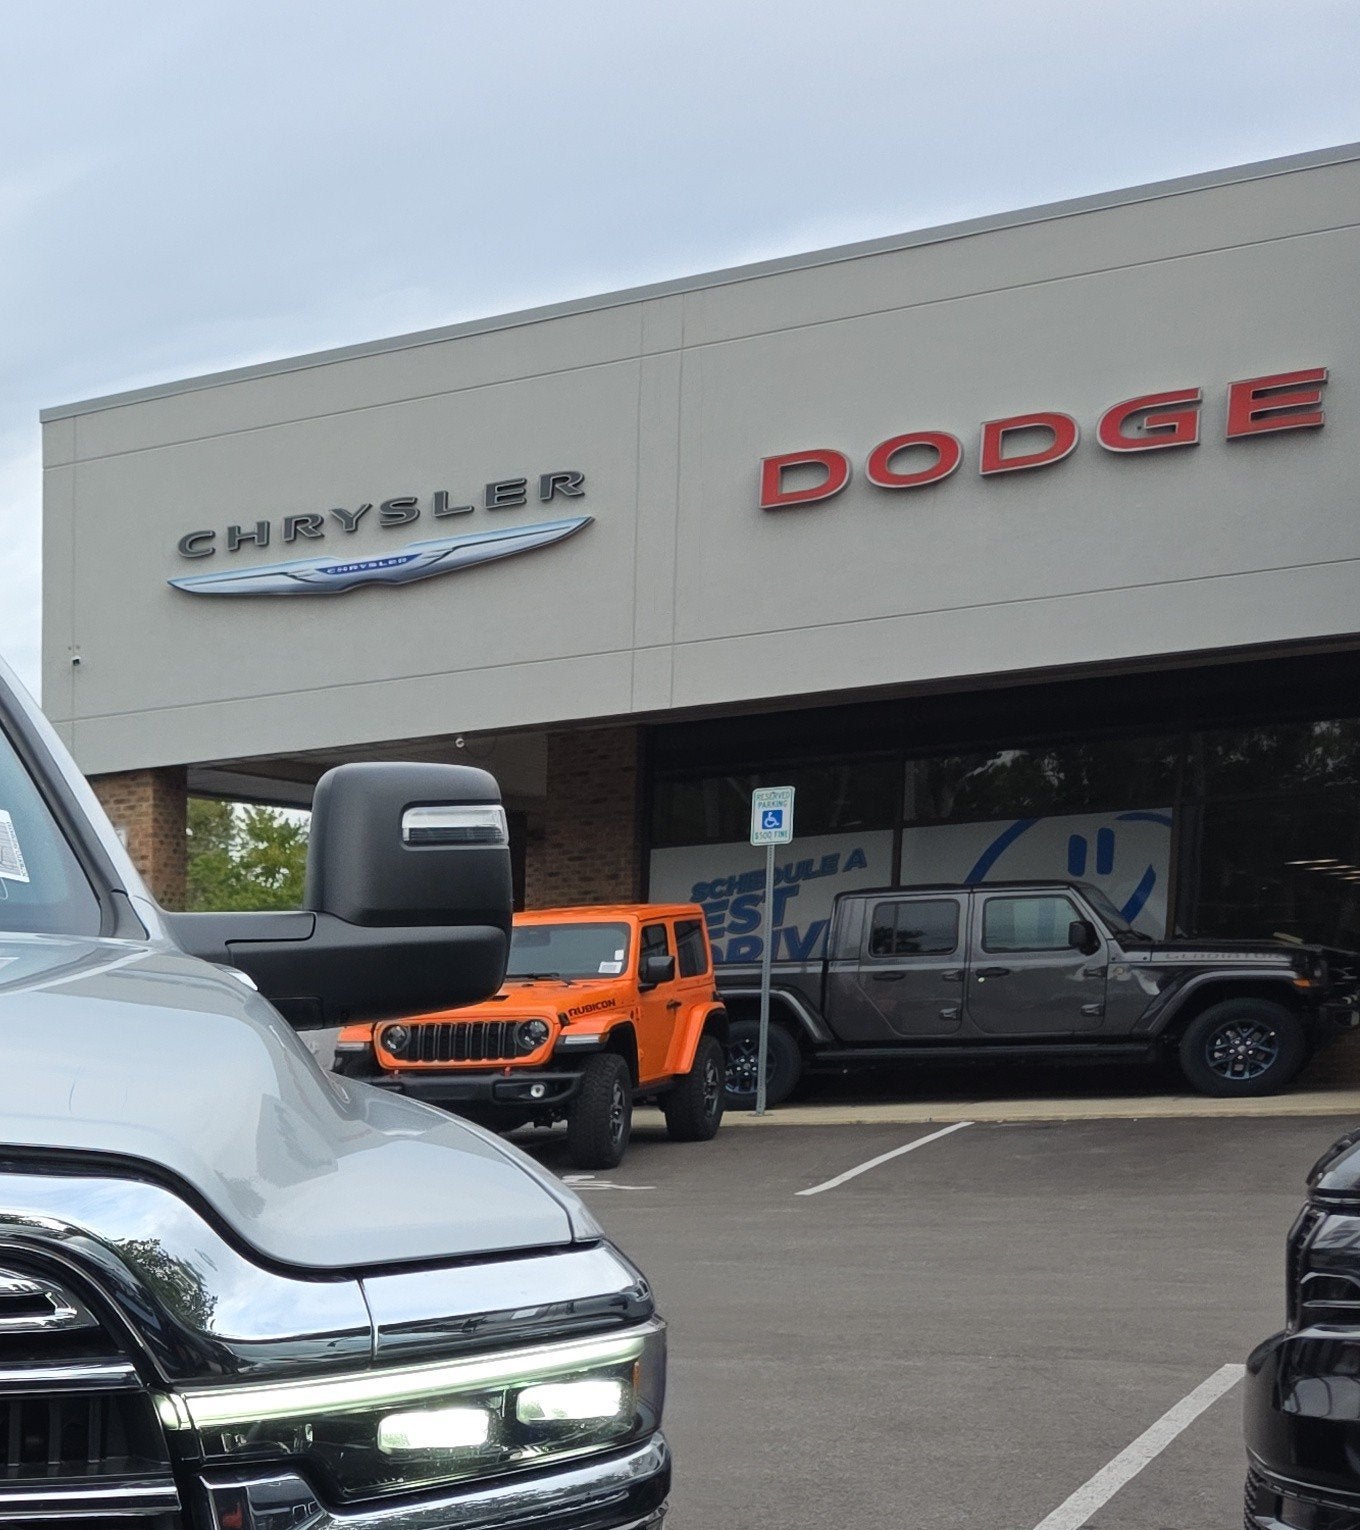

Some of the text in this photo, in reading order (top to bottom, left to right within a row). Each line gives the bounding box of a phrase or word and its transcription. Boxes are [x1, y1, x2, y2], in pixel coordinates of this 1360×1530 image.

[758, 366, 1329, 510] DODGE
[177, 469, 585, 558] CHRYSLER
[326, 557, 407, 574] CHRYSLER
[756, 791, 790, 801] RESERVED
[757, 800, 787, 808] PARKING
[690, 847, 868, 902] SCHEDULE A
[701, 884, 800, 939] EST
[712, 919, 831, 962] RIV
[568, 998, 616, 1016] RUBICON
